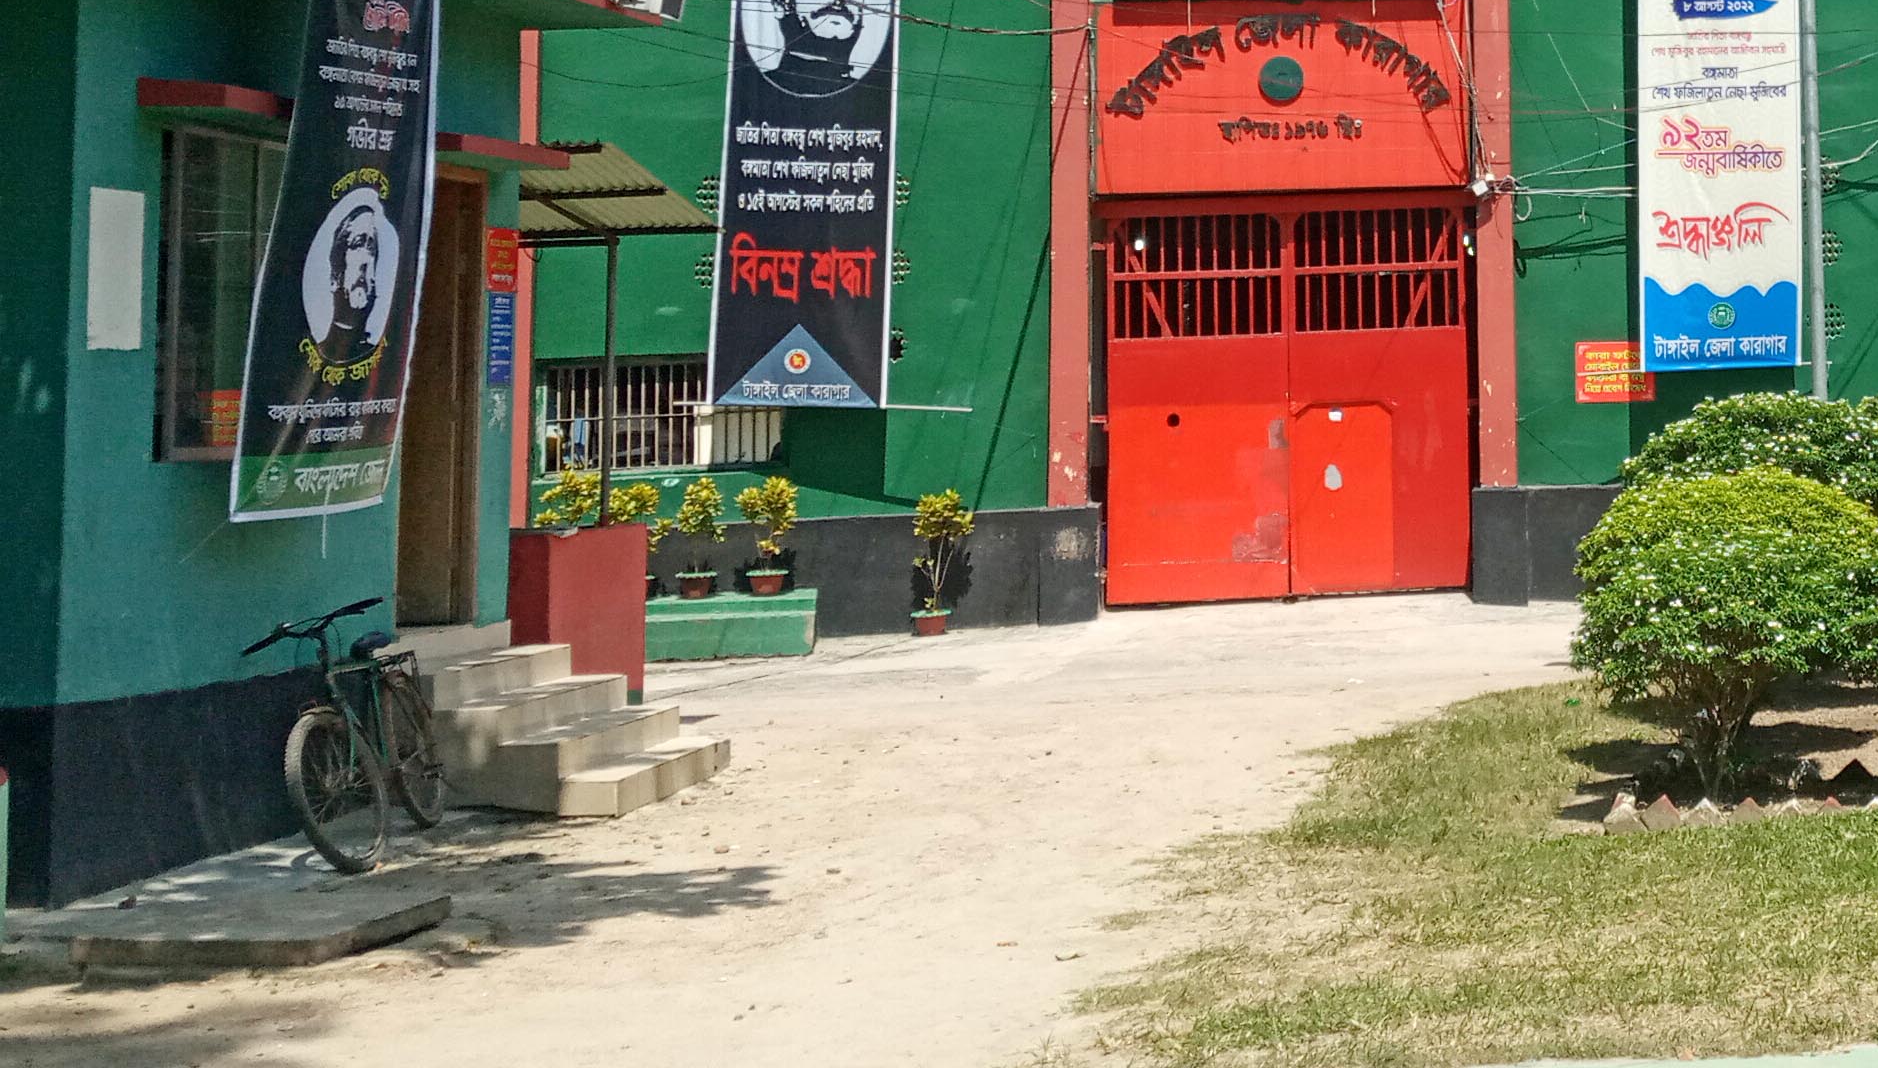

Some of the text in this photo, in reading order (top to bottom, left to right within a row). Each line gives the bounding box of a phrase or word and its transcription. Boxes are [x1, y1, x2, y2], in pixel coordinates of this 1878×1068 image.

[1683, 1, 1692, 13] ৮
[1727, 1, 1755, 13] ২০২২
[1105, 12, 1452, 121] টাঙ্গাইল জেলা কারাগার
[1701, 67, 1738, 81] বঙ্গমাতা
[1652, 85, 1671, 100] শেখ
[1674, 82, 1722, 103] ফজিলাতুন
[1750, 81, 1787, 102] মুজিবের
[347, 118, 377, 151] গভীর
[736, 120, 884, 152] জাতির পিতা বঙ্গবন্ধু শেখ মুজিবুর রহমান,
[1662, 118, 1728, 150] ৯২তম
[741, 155, 875, 185] বঙ্গমাতা শেখ ফজিলাতুন নেছা মুজিব
[1658, 143, 1784, 176] জন্মবার্ষিকীতে
[738, 193, 746, 209] ও
[747, 188, 765, 213] ১৫ই
[767, 188, 801, 212] আগস্টের
[803, 194, 824, 213] সকল
[857, 188, 875, 213] প্রতি
[1652, 201, 1789, 261] শ্রদ্ধাঞ্জলি
[729, 231, 877, 304] বিনম্র শ্রদ্ধা
[1654, 333, 1788, 361] টাঙ্গাইল জেলা কারাগার
[742, 379, 851, 401] টাঙ্গাইল জেলা কারাগার
[294, 462, 361, 495] বাংলাদেশ
